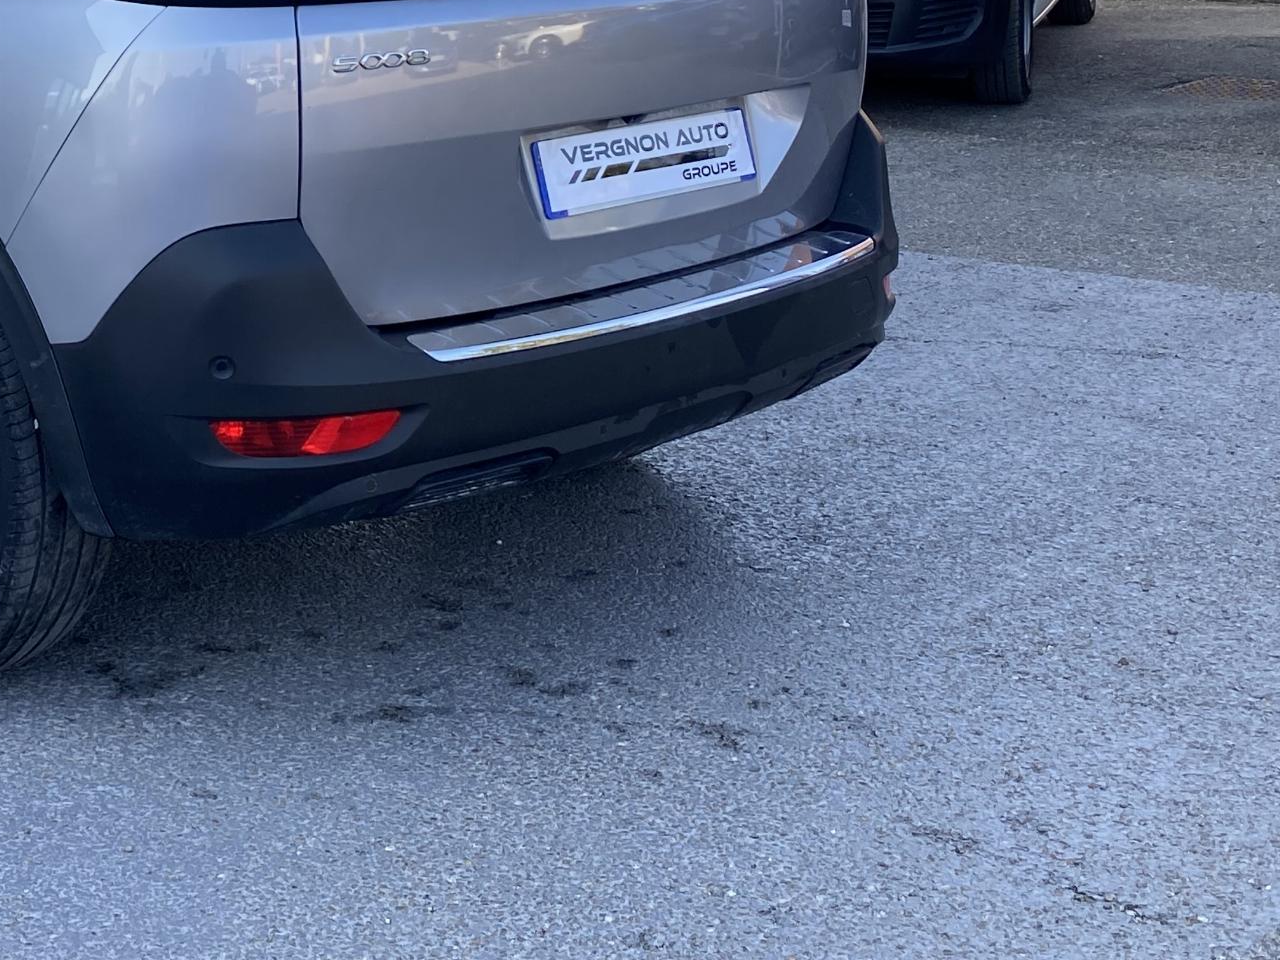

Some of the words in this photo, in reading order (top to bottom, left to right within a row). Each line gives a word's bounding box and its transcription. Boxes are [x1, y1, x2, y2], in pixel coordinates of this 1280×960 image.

[332, 49, 432, 74] 5008
[560, 129, 669, 165] VERGNON
[676, 122, 730, 148] AUTO
[682, 159, 738, 181] GROUPE
